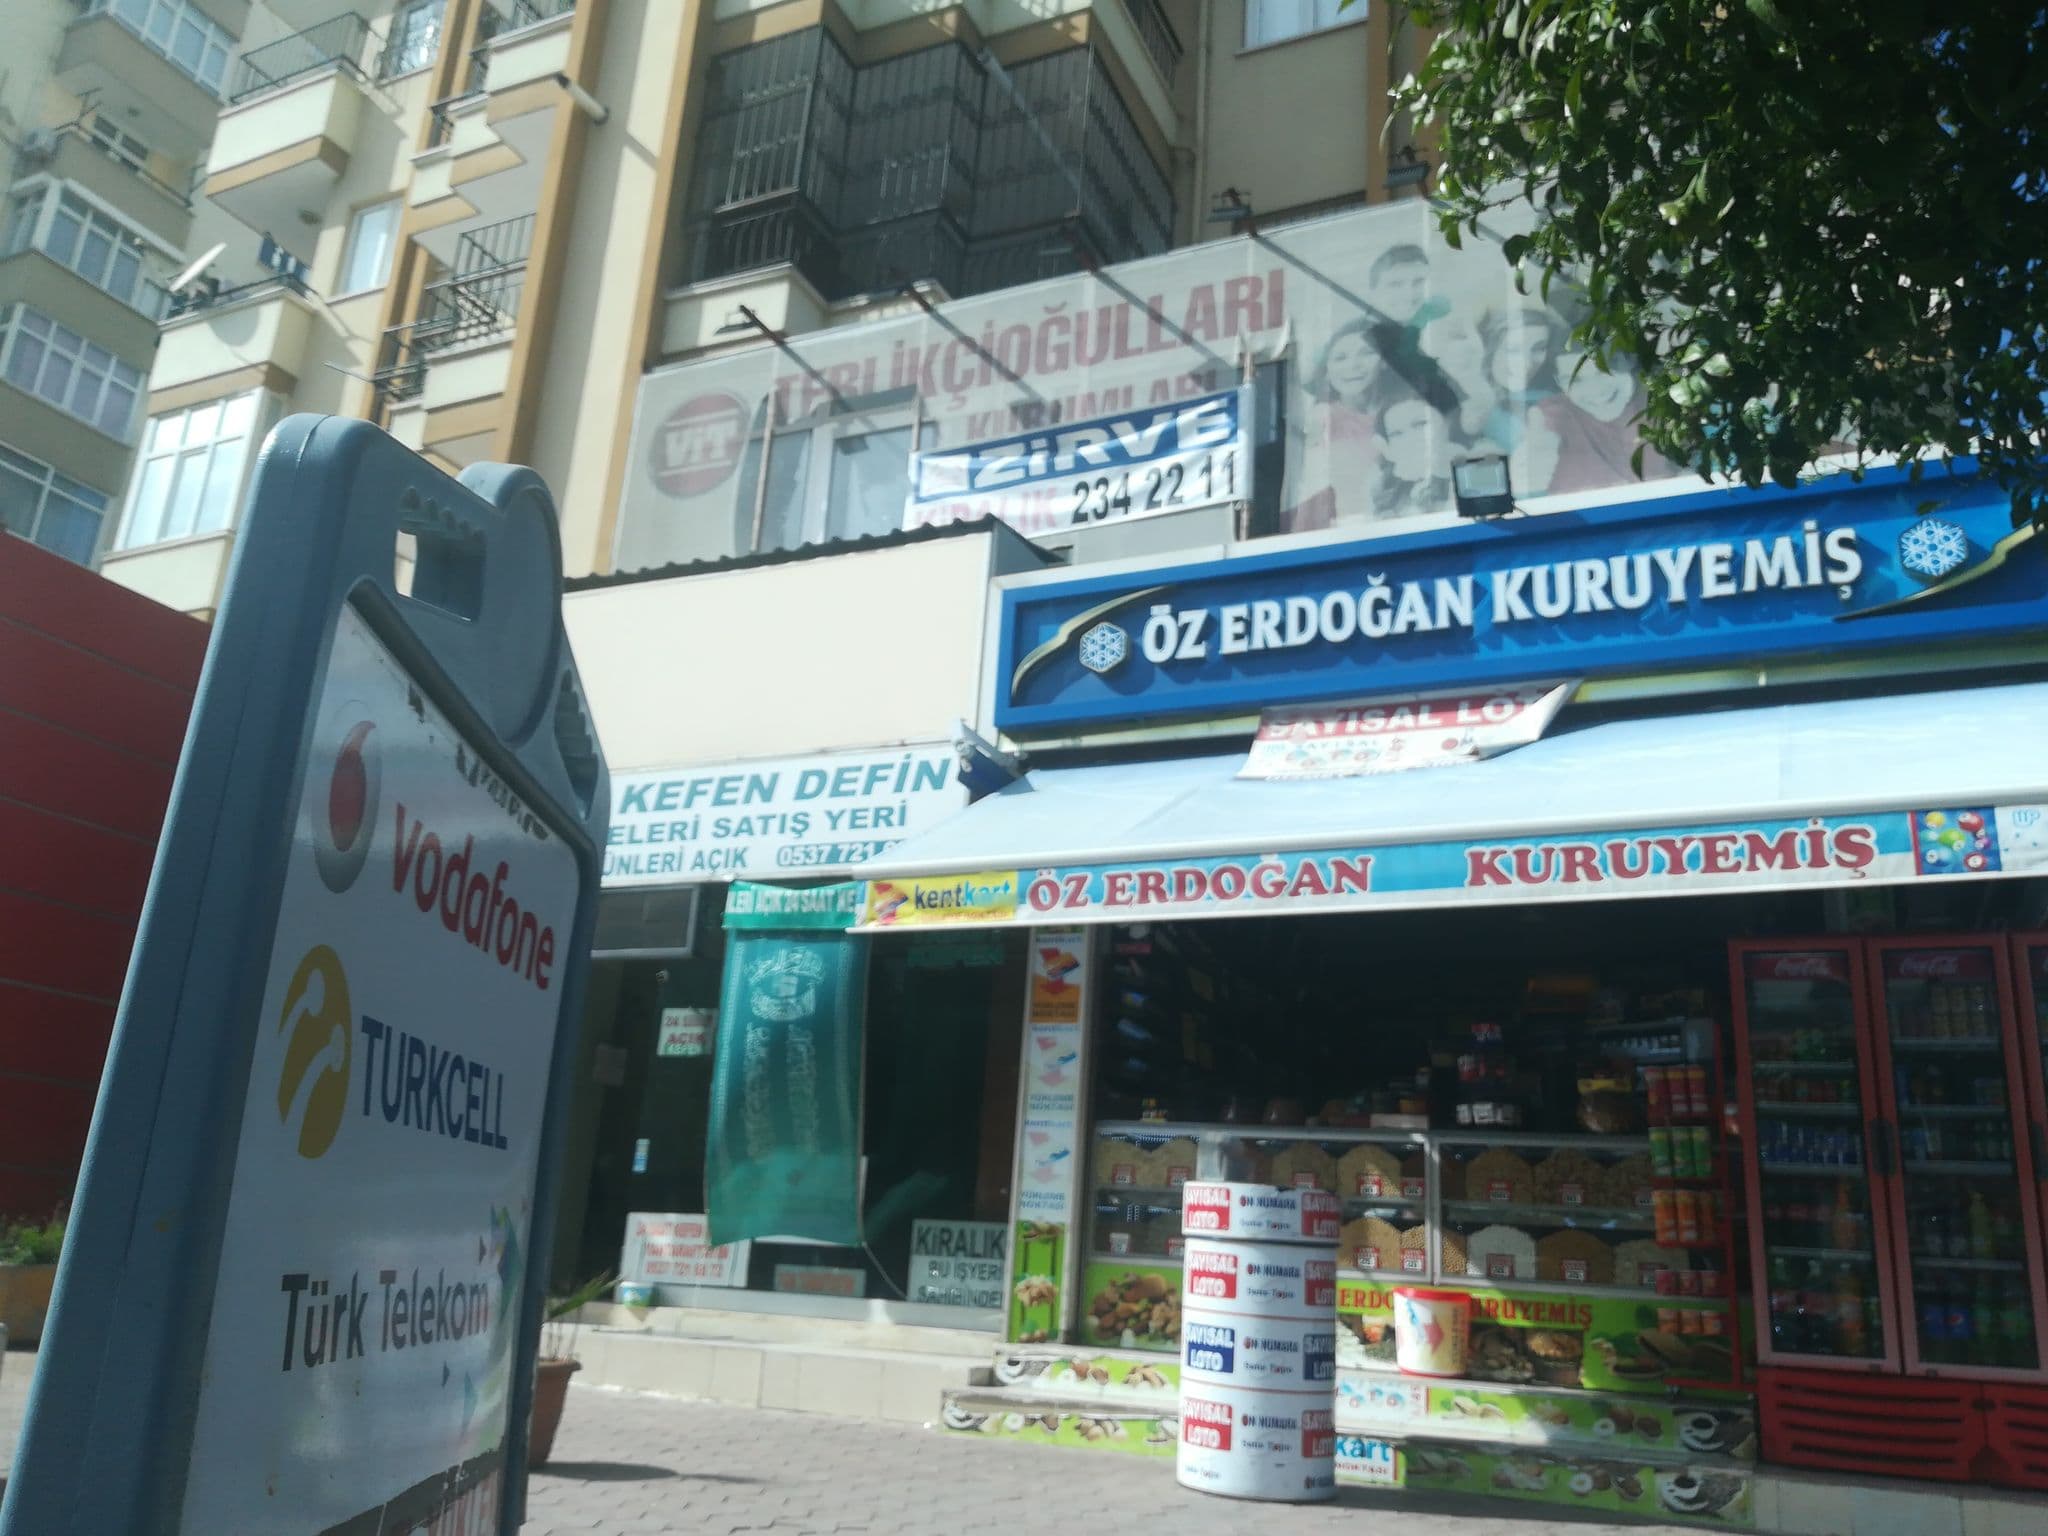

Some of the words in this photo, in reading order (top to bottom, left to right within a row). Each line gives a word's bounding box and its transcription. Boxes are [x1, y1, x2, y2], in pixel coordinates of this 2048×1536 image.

[1071, 471, 1131, 524] 234
[1144, 462, 1184, 511] 22
[1199, 450, 1235, 499] 11
[1141, 603, 1209, 664] ÖZ
[1219, 572, 1474, 655] ERDOĞAN
[1491, 519, 1864, 624] KURUYEMİŞ
[618, 772, 780, 815] KEFEN
[793, 752, 952, 801] DEFİN
[712, 810, 811, 839] SATIŞ
[824, 799, 909, 831] YERİ
[691, 846, 749, 873] AÇIK
[779, 843, 832, 866] 0537
[1026, 868, 1091, 912] ÖZ
[1102, 854, 1374, 908] ERDOĞAN
[1465, 817, 1877, 888] KURUYEMİŞ
[361, 1015, 508, 1150] TURKCELL
[281, 1272, 369, 1372] Türk
[379, 1267, 489, 1353] Telekom
